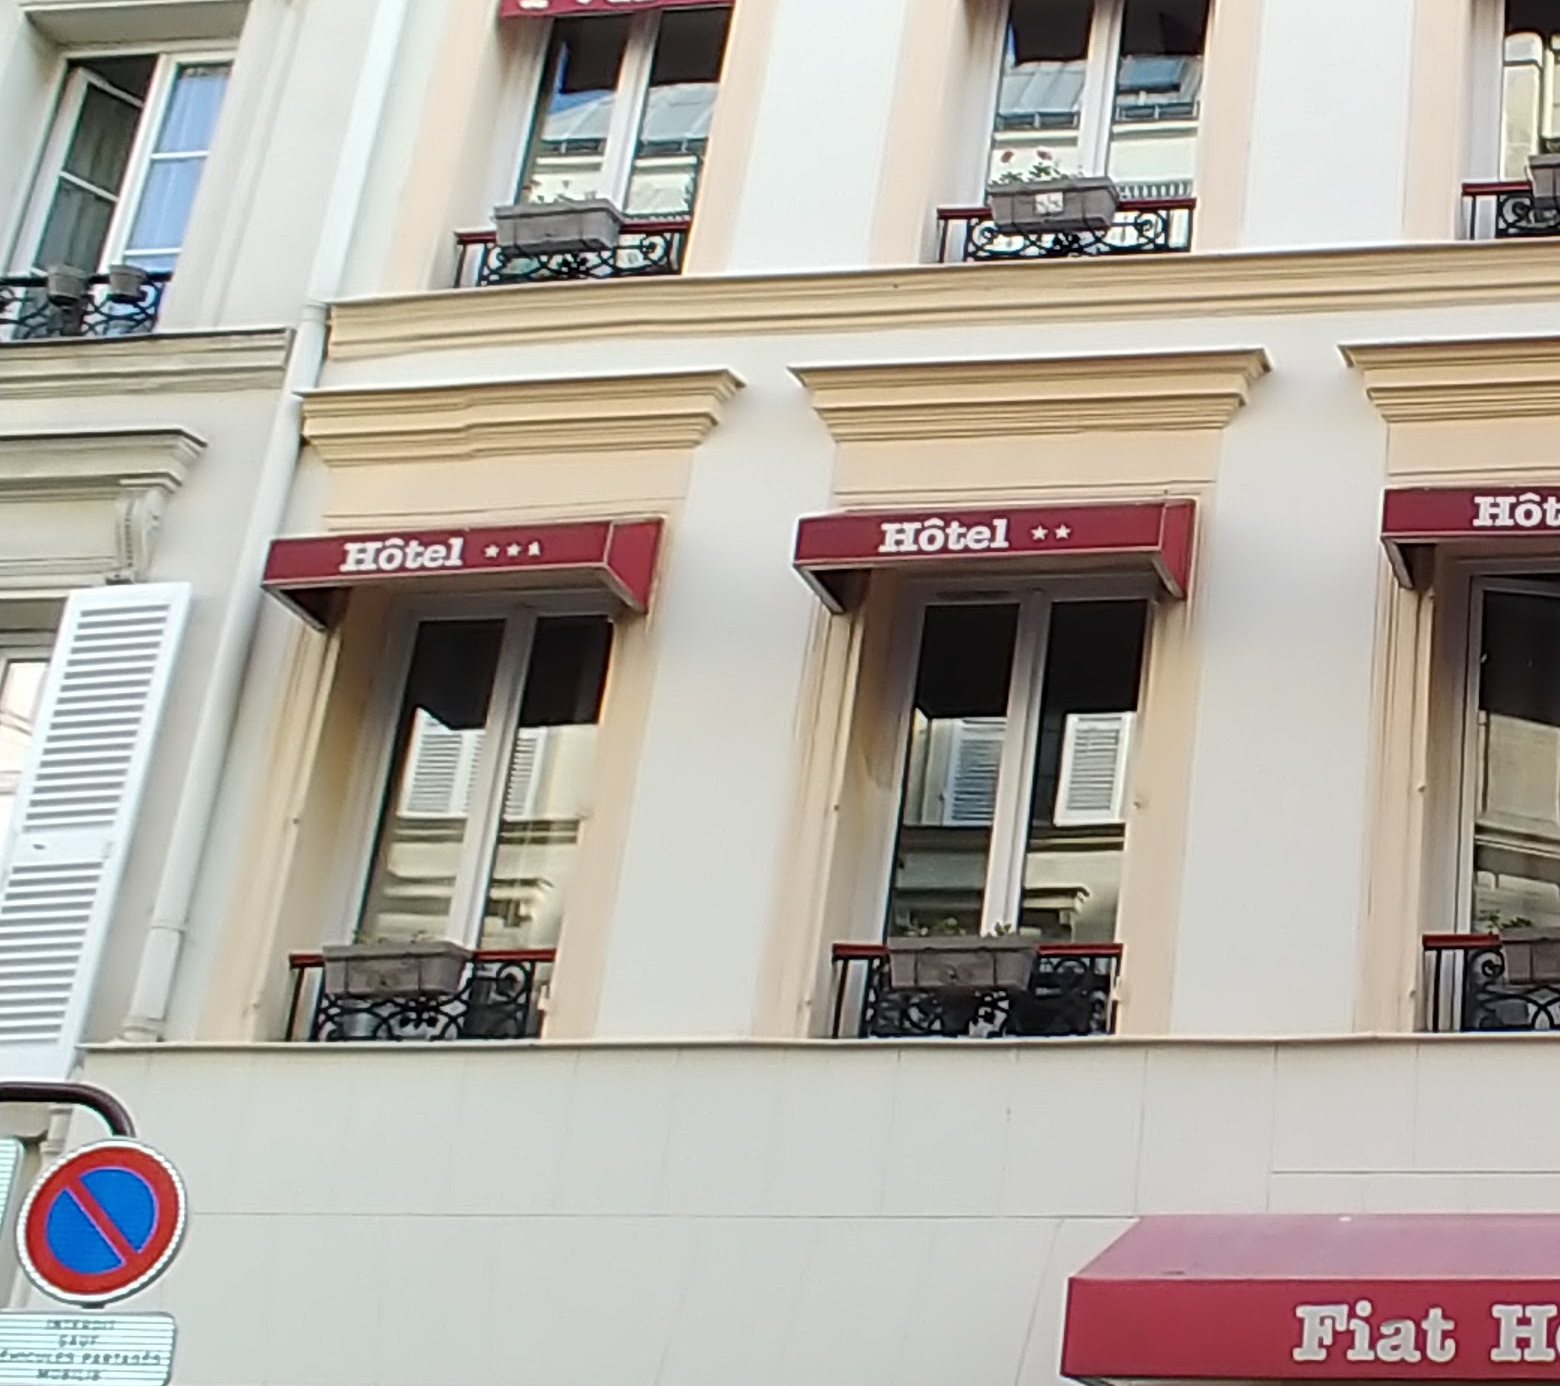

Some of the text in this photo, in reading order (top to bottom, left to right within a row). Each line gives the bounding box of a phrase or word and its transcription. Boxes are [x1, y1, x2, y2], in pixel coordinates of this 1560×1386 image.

[339, 534, 464, 574] Hôtel
[877, 516, 1010, 555] Hôtel
[1292, 1299, 1456, 1363] Fiat
